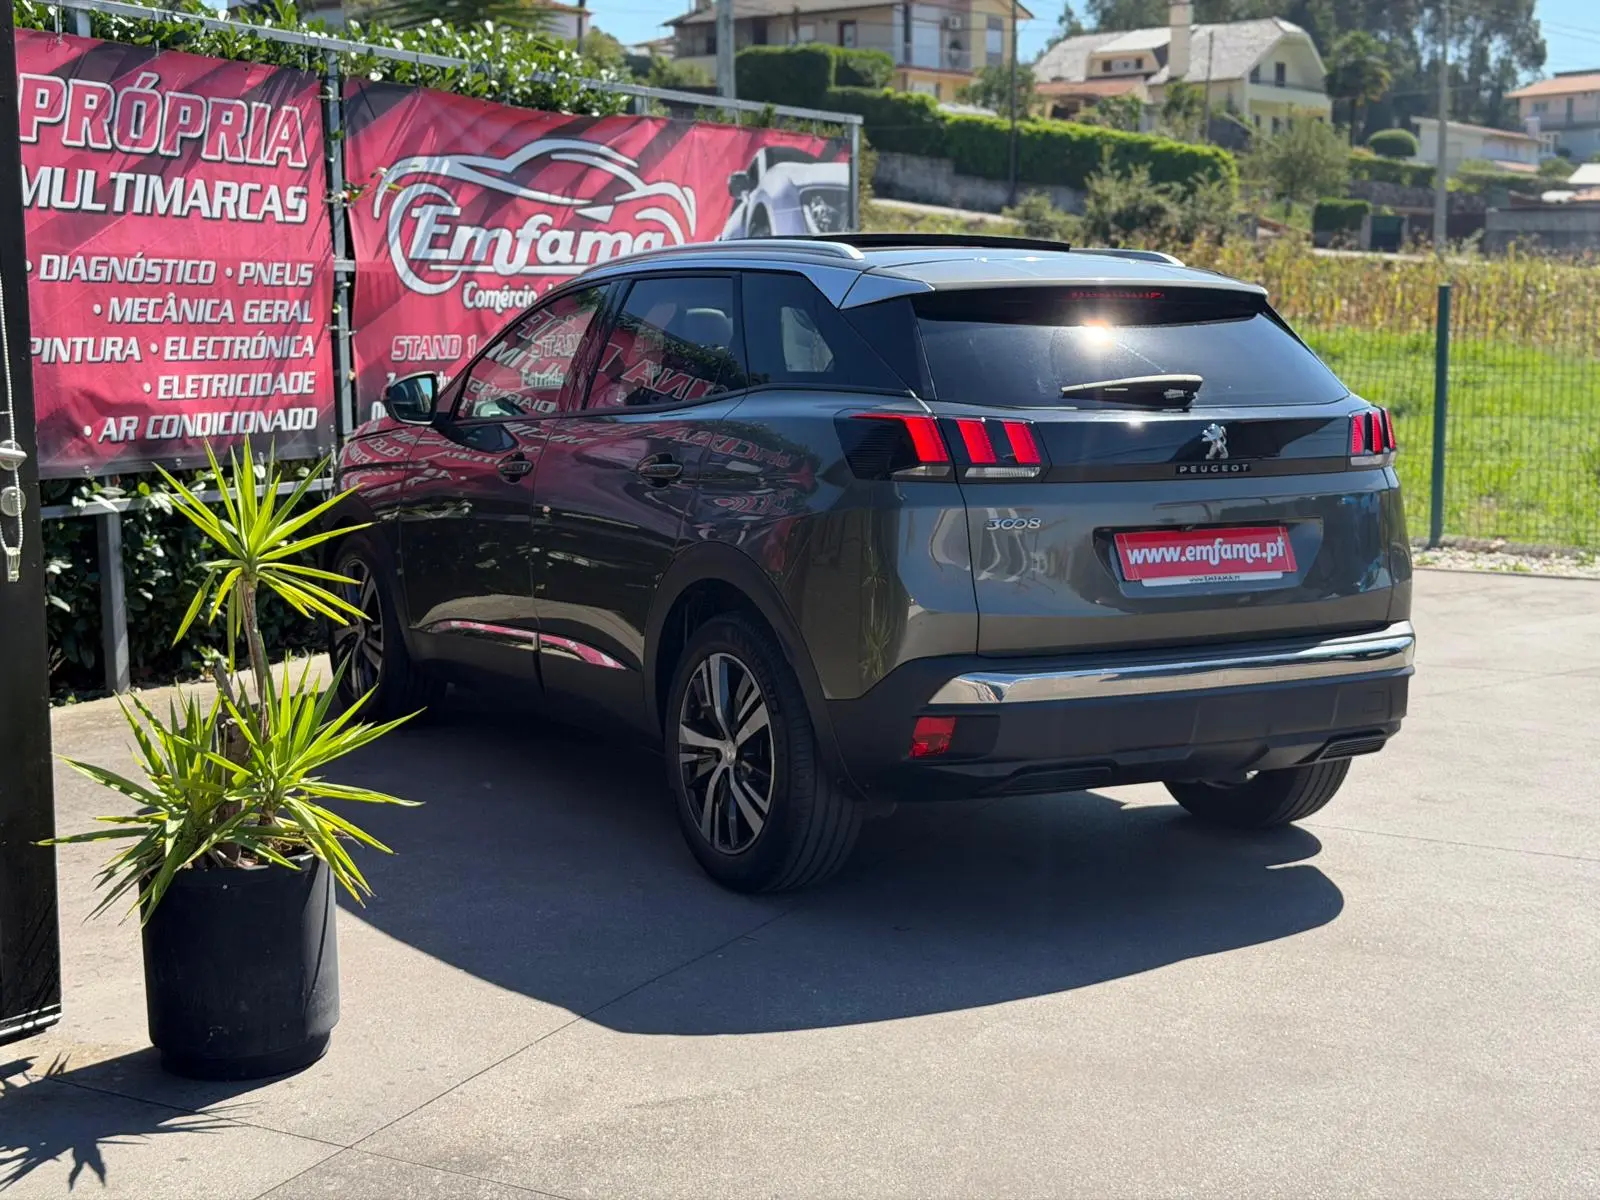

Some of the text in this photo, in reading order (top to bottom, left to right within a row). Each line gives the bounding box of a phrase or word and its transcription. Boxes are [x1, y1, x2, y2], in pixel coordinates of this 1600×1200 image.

[18, 72, 307, 168] PRÓPRIA
[21, 163, 308, 223] MULTIMARCAS
[39, 252, 314, 287] DIAGNÓSTICO PNEUS
[107, 292, 314, 324] MECÂNICA GERAL
[463, 281, 538, 314] Comércio
[164, 331, 315, 361] ELECTRÓNICA
[391, 335, 463, 361] STAND
[158, 371, 317, 400] ELETRICIDADE
[98, 407, 318, 443] AR CONDICIONADO
[1178, 463, 1249, 474] PEUGEOT
[986, 517, 1042, 531] 3008
[1126, 535, 1285, 566] www.emfama.pt
